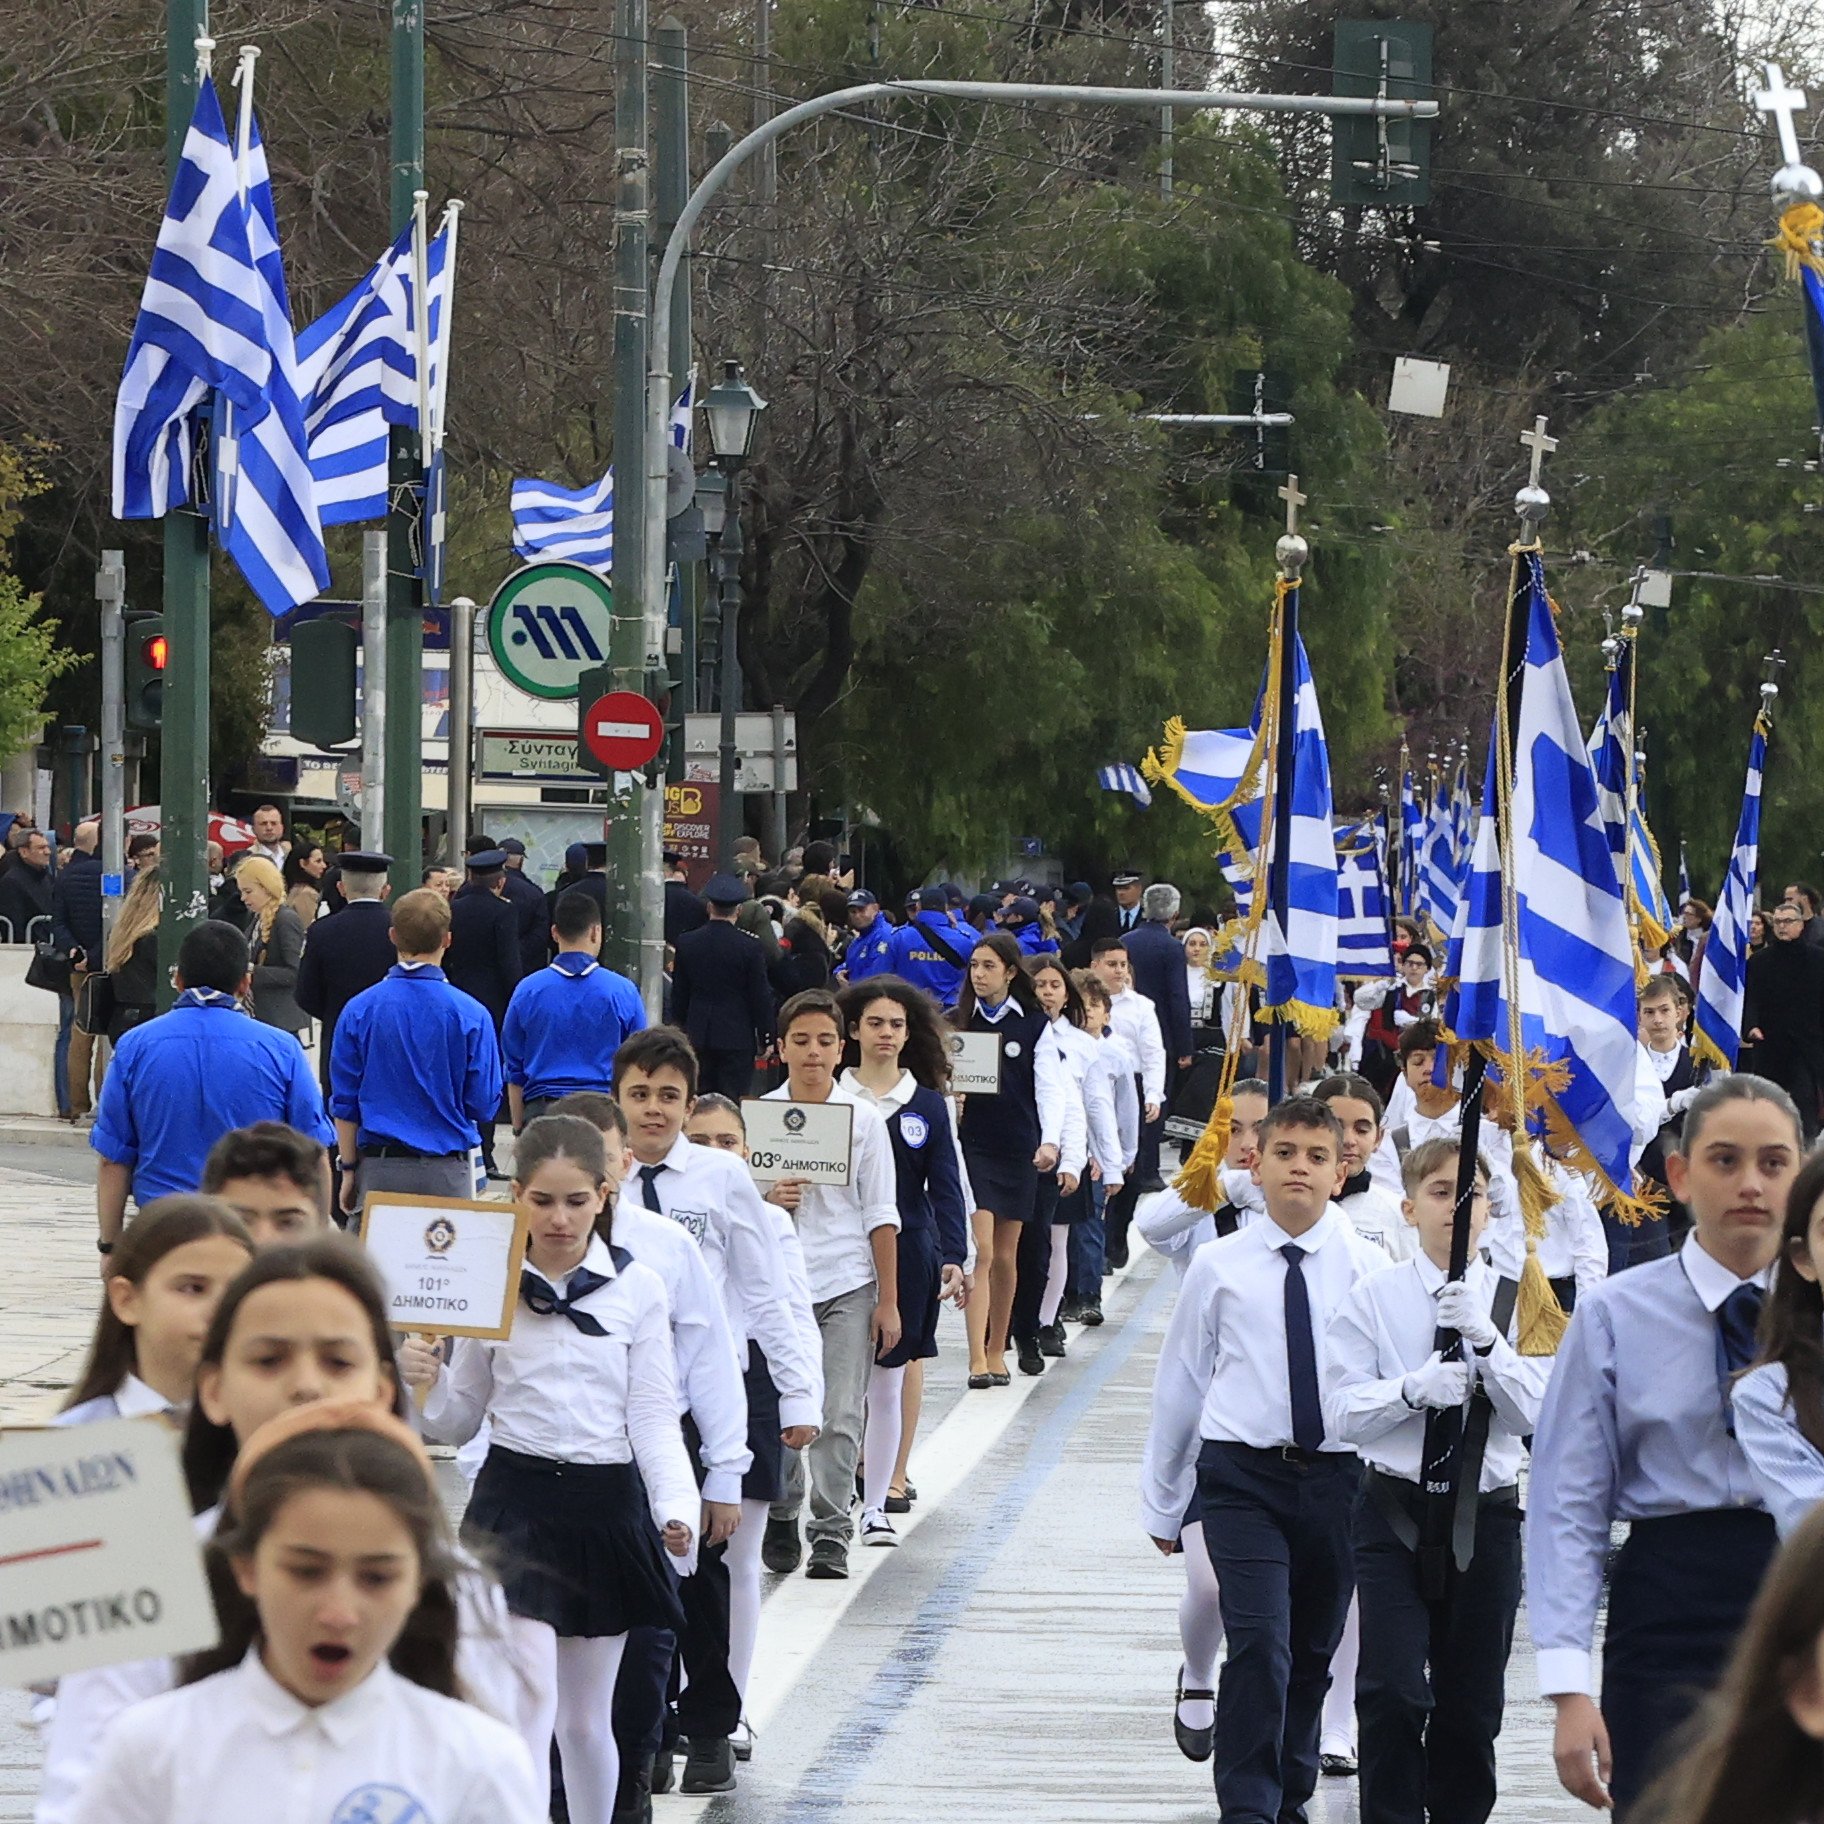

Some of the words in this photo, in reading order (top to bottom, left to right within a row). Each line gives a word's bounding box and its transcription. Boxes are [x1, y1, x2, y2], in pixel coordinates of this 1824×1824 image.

[508, 740, 579, 760] Σύνταγ
[664, 786, 680, 801] IG
[781, 1159, 847, 1174] ΔΗΜΟΤΙΚΟ
[392, 1294, 469, 1312] ΔΗΜΟΤΙΚΟ
[0, 1587, 163, 1649] ΜΟΤΙΚΟ
